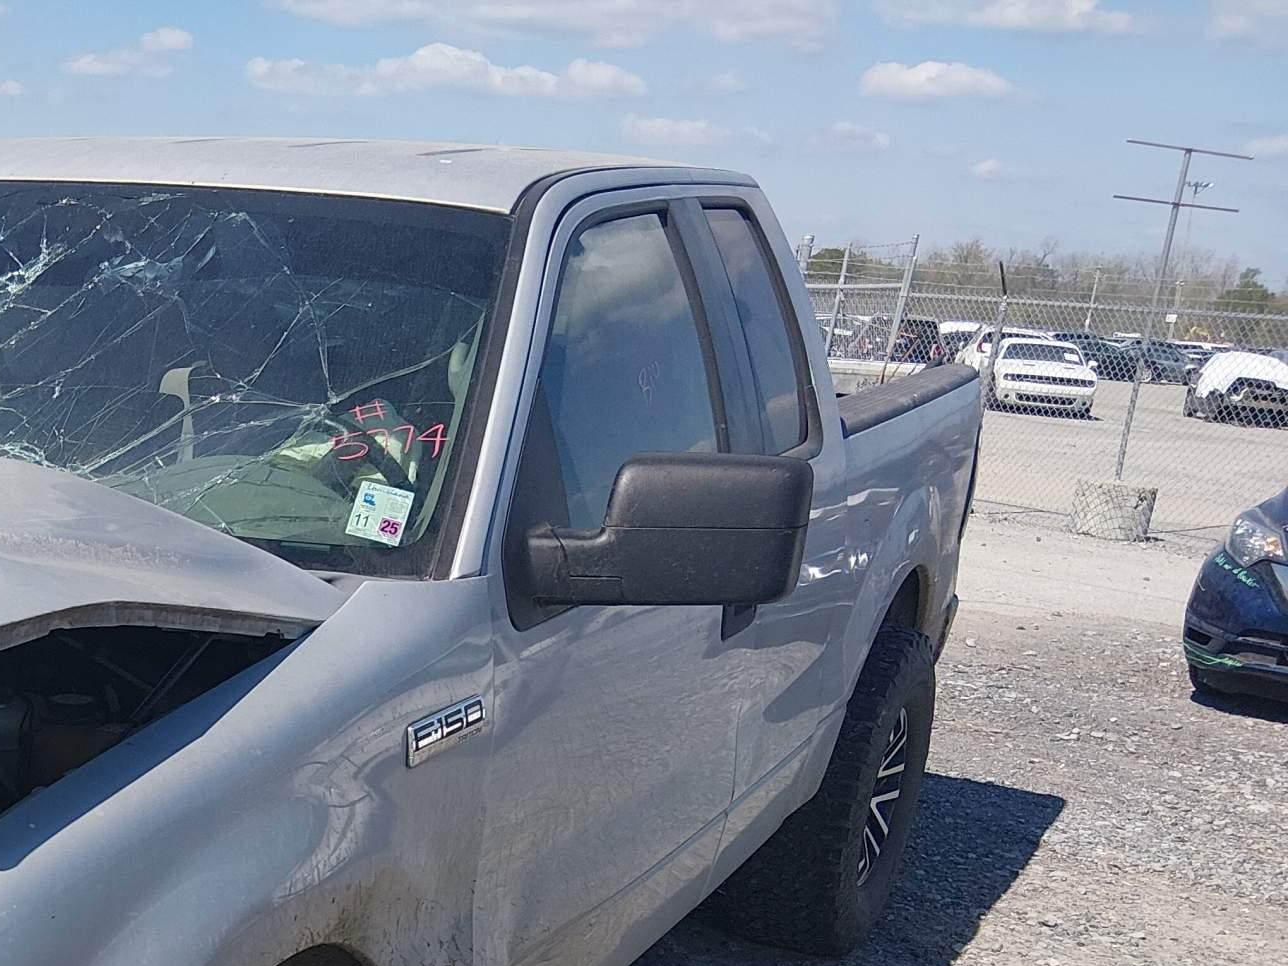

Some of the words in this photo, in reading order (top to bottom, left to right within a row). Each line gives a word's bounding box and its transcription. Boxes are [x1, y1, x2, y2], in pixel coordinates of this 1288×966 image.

[329, 423, 450, 460] 5774
[355, 513, 370, 527] 11
[380, 519, 400, 536] 25
